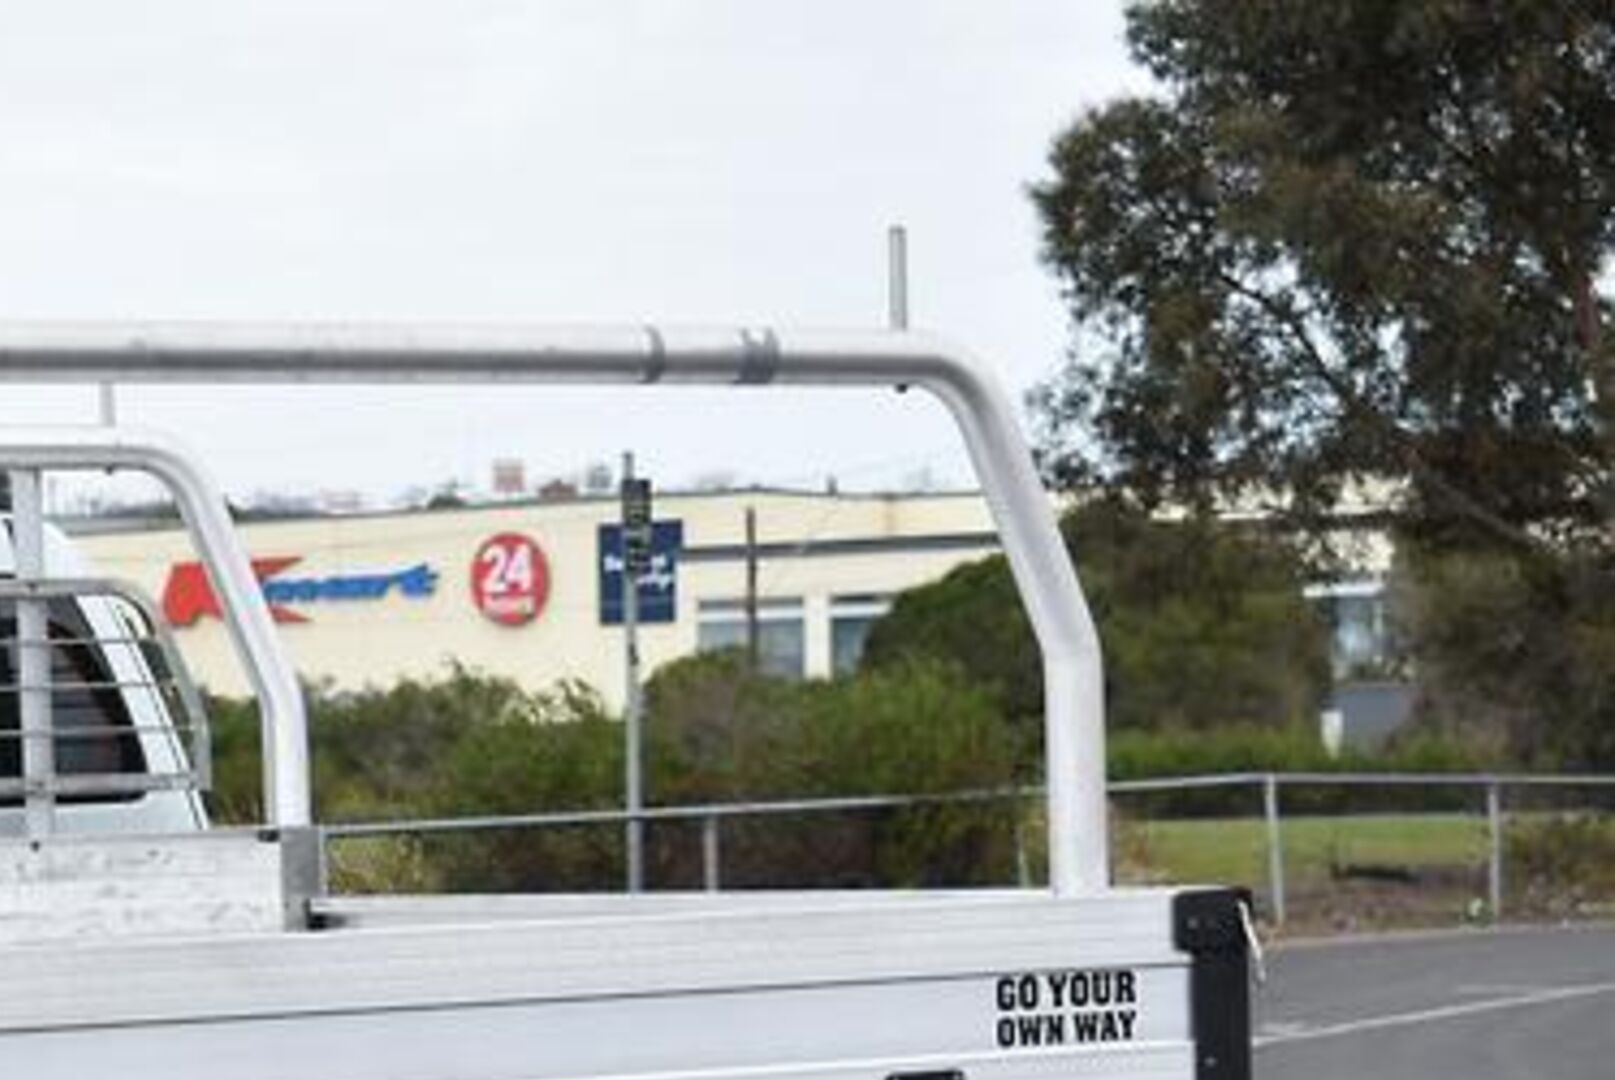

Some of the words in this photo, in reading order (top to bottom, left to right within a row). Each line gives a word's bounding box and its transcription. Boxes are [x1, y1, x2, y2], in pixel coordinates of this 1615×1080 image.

[483, 544, 531, 592] 24
[996, 974, 1038, 1011] GO
[1048, 970, 1136, 1007] YOUR
[997, 1016, 1064, 1047] OWN
[1074, 1010, 1136, 1042] WAY
